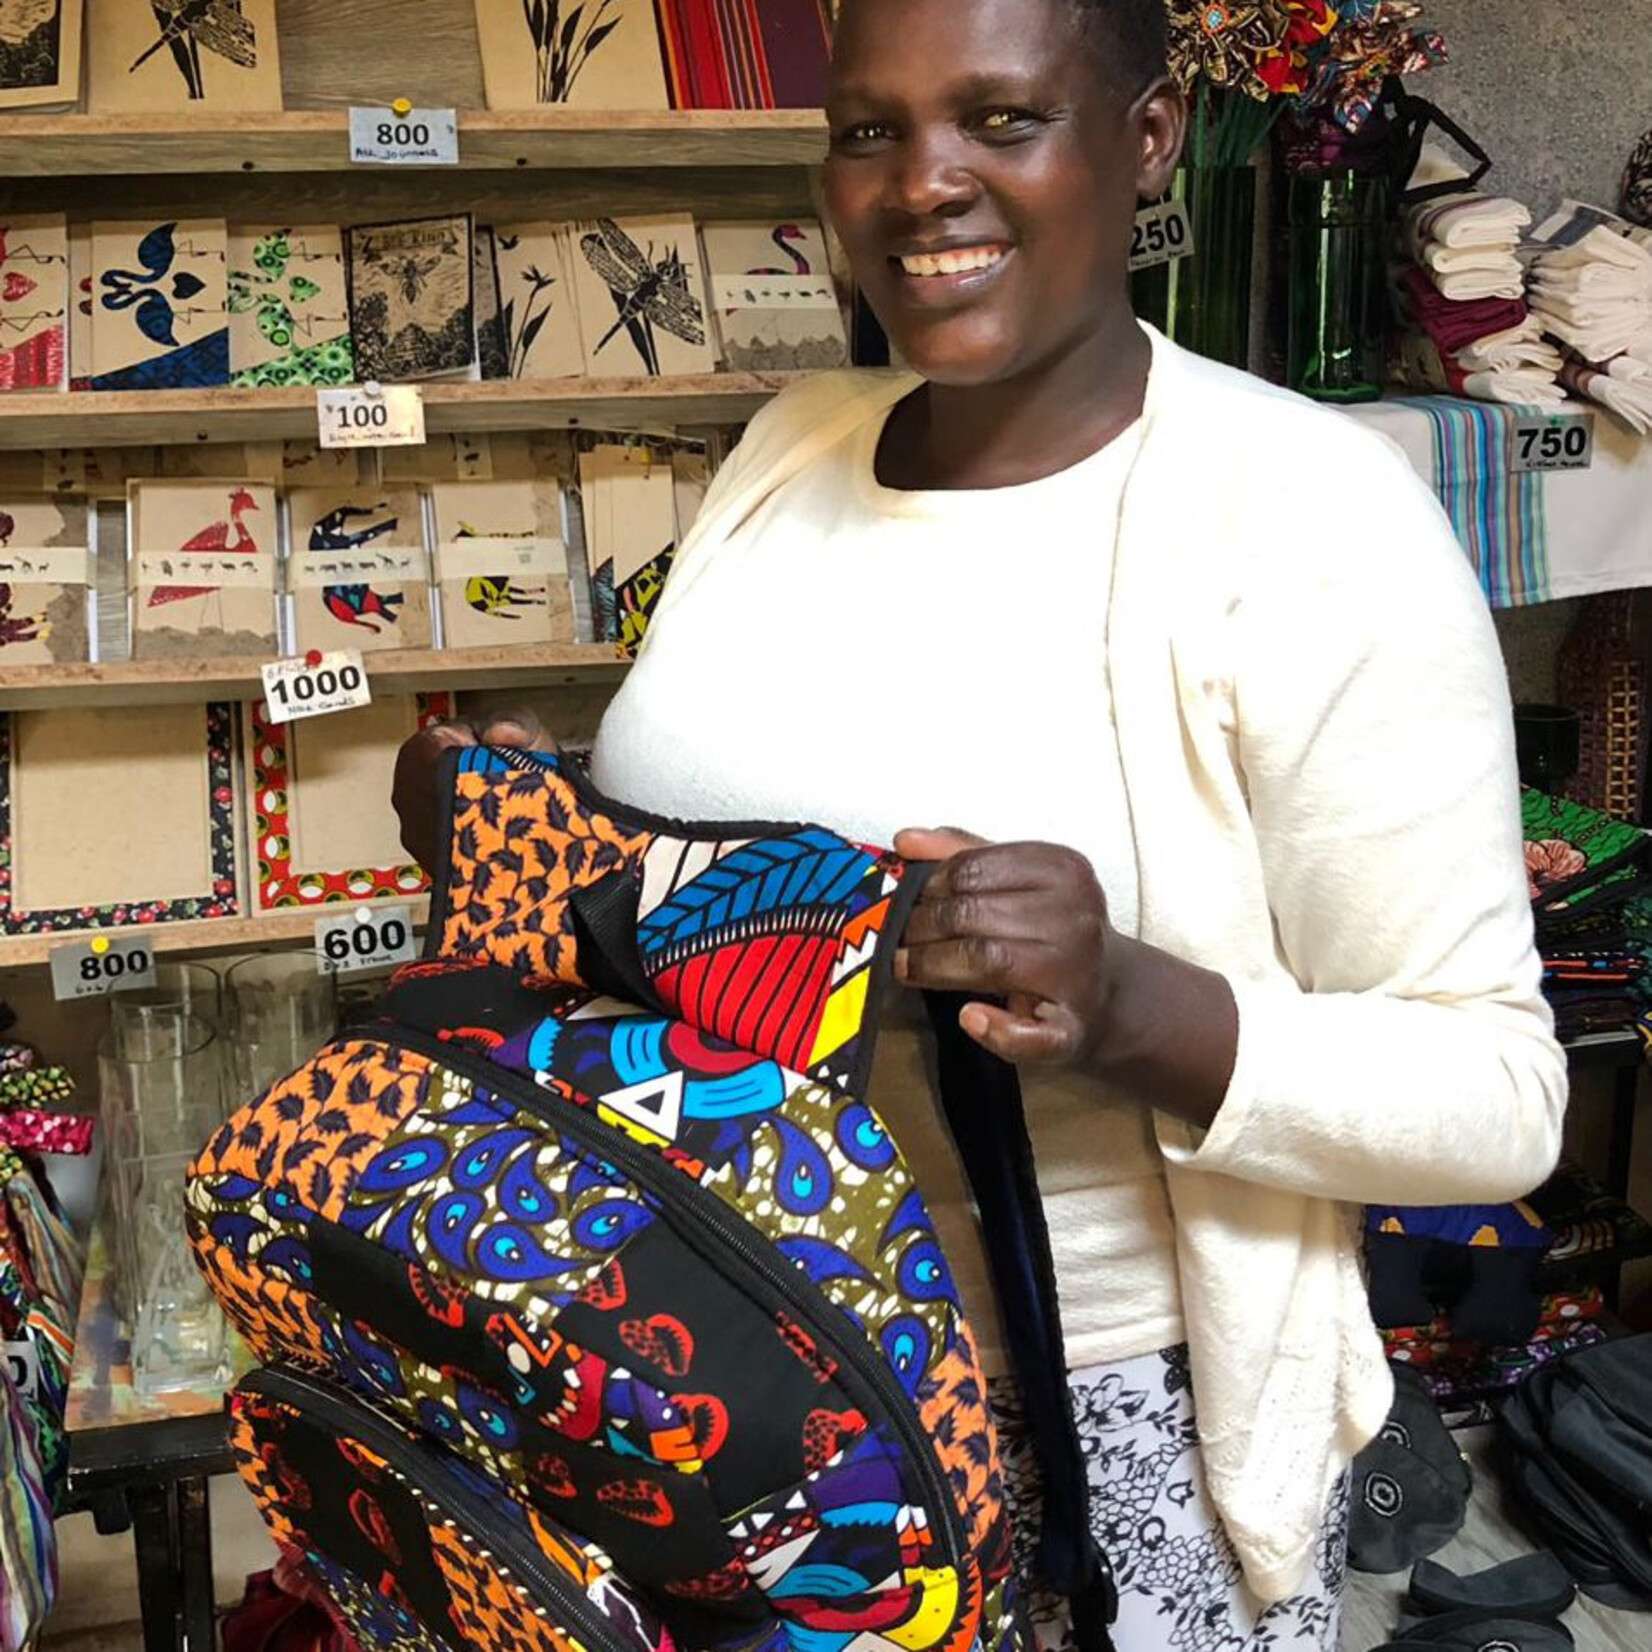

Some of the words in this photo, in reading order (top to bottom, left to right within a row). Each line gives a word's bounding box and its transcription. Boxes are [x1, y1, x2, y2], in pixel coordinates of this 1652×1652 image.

[376, 123, 429, 146] 800
[1130, 214, 1185, 257] 250
[337, 404, 387, 428] 100
[1517, 426, 1587, 459] 750
[271, 665, 361, 704] 1000
[324, 919, 406, 960] 600
[81, 950, 148, 981] 800
